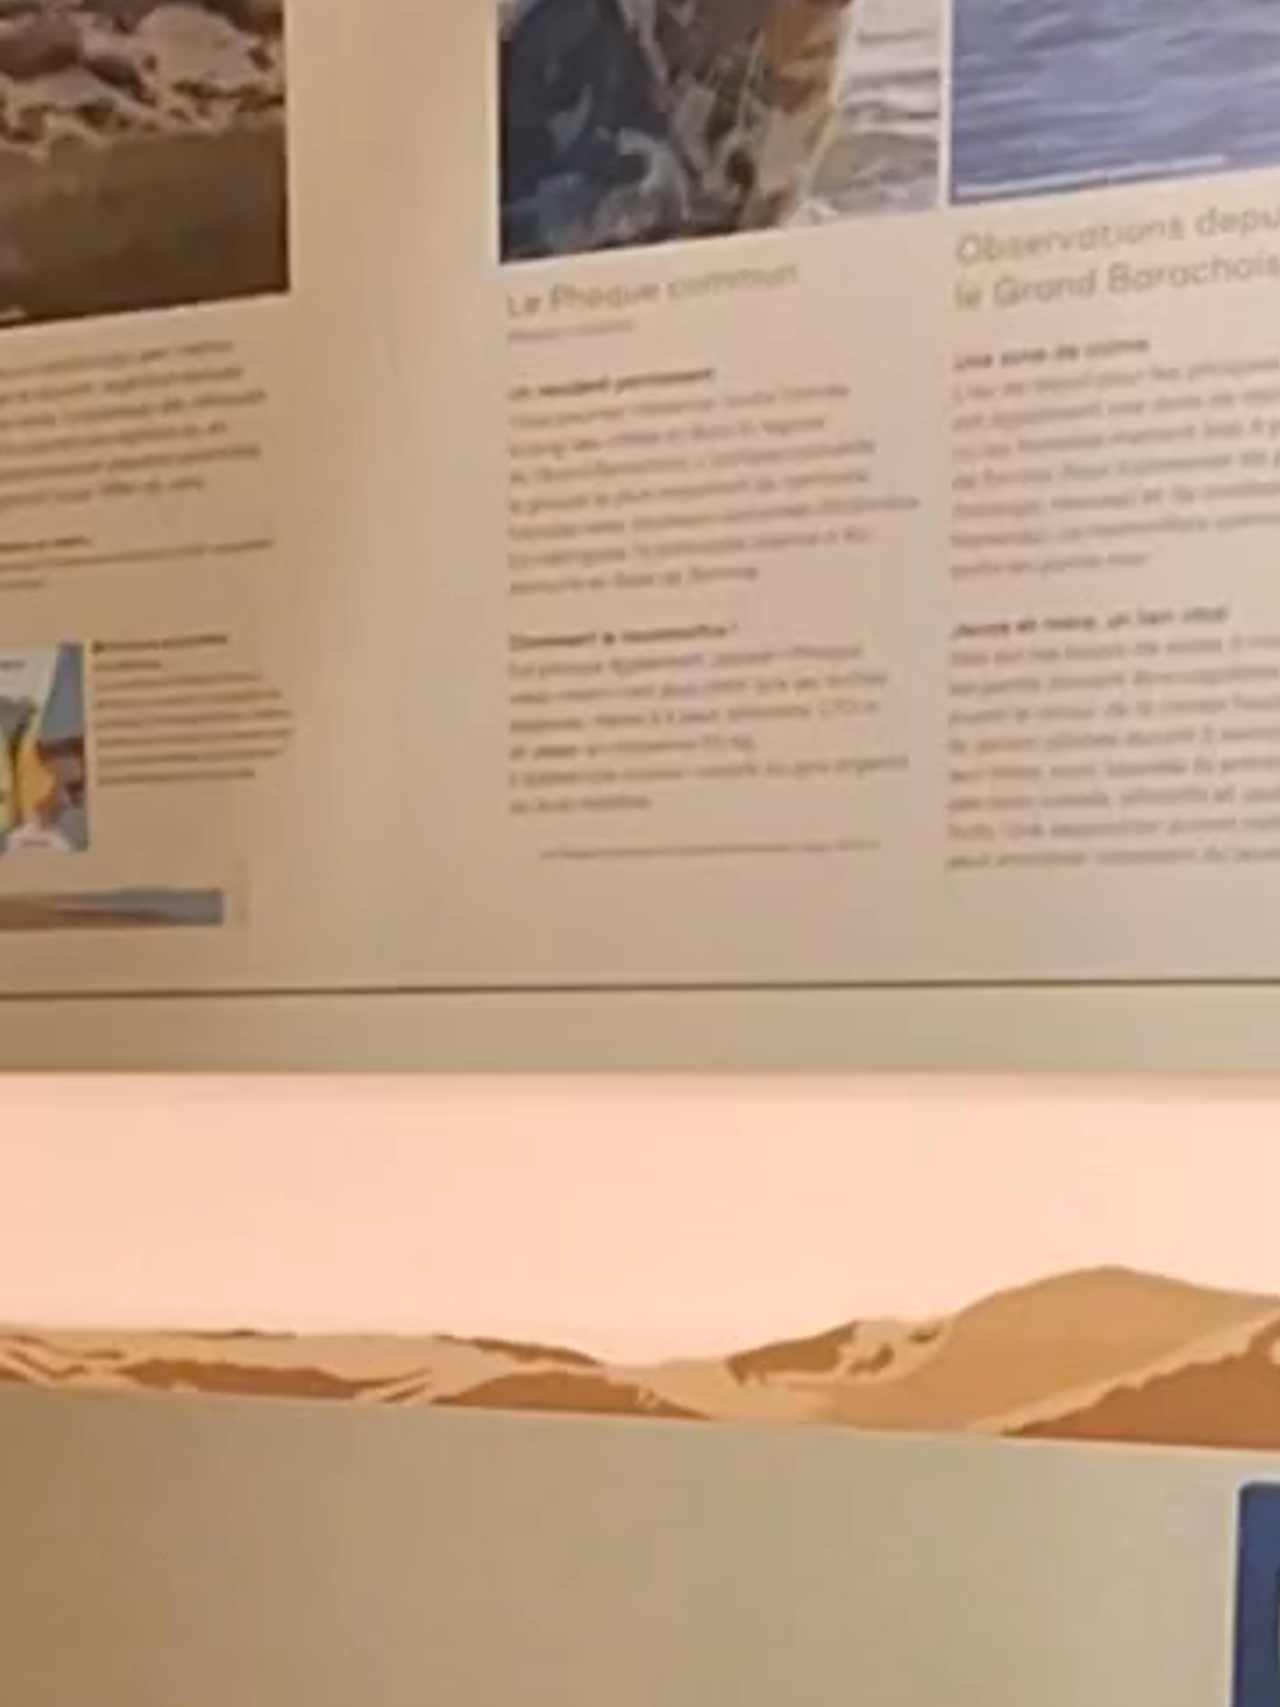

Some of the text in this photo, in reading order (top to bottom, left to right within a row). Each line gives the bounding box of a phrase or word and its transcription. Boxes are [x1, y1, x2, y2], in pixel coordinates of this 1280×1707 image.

[955, 213, 1185, 265] Observations
[955, 277, 982, 309] le
[993, 269, 1098, 307] Grand
